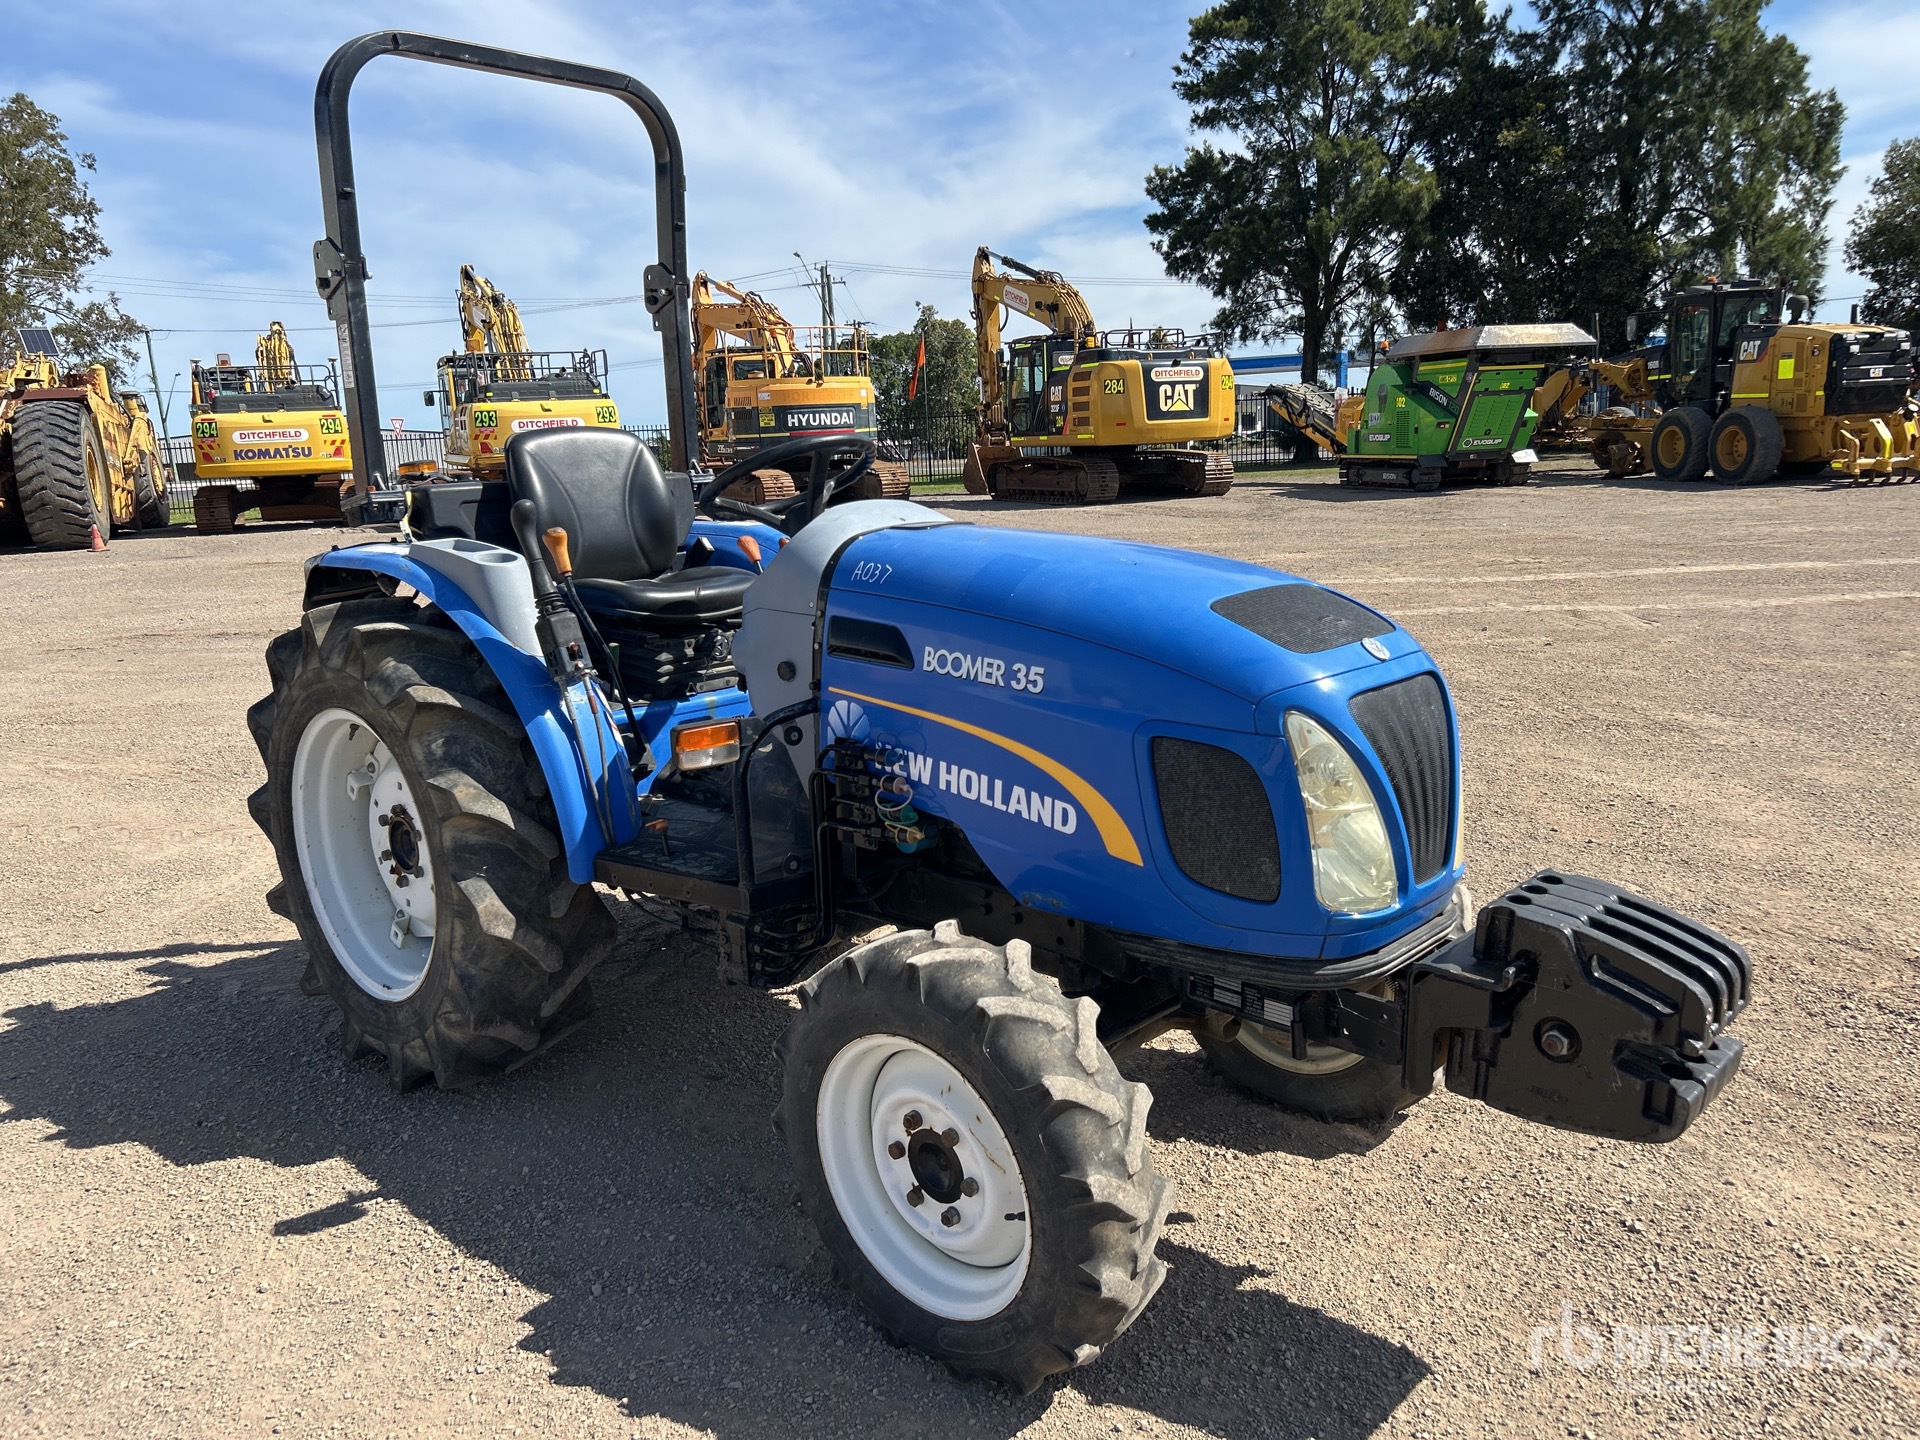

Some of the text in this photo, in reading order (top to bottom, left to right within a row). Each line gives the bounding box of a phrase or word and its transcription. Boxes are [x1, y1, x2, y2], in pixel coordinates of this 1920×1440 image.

[1739, 340, 1761, 361] CAT
[1154, 369, 1201, 378] DITCHFIELD
[1104, 379, 1125, 395] 284
[1221, 375, 1234, 390] 284
[1050, 385, 1063, 402] CAT
[1159, 384, 1197, 412] CAT
[1429, 387, 1448, 407] BISON
[474, 411, 498, 427] 293
[597, 407, 617, 423] 293
[787, 411, 854, 427] HYUNDAI
[196, 422, 218, 438] 294
[320, 418, 342, 434] 294
[518, 419, 579, 429] DITCHFIELD
[239, 430, 302, 440] DITCHFIELD
[1473, 438, 1503, 446] EVOQUIP
[233, 445, 313, 461] KOMATSU
[851, 561, 893, 585] A037
[922, 646, 1045, 694] BOOMER 35
[939, 761, 1077, 836] HOLLAND
